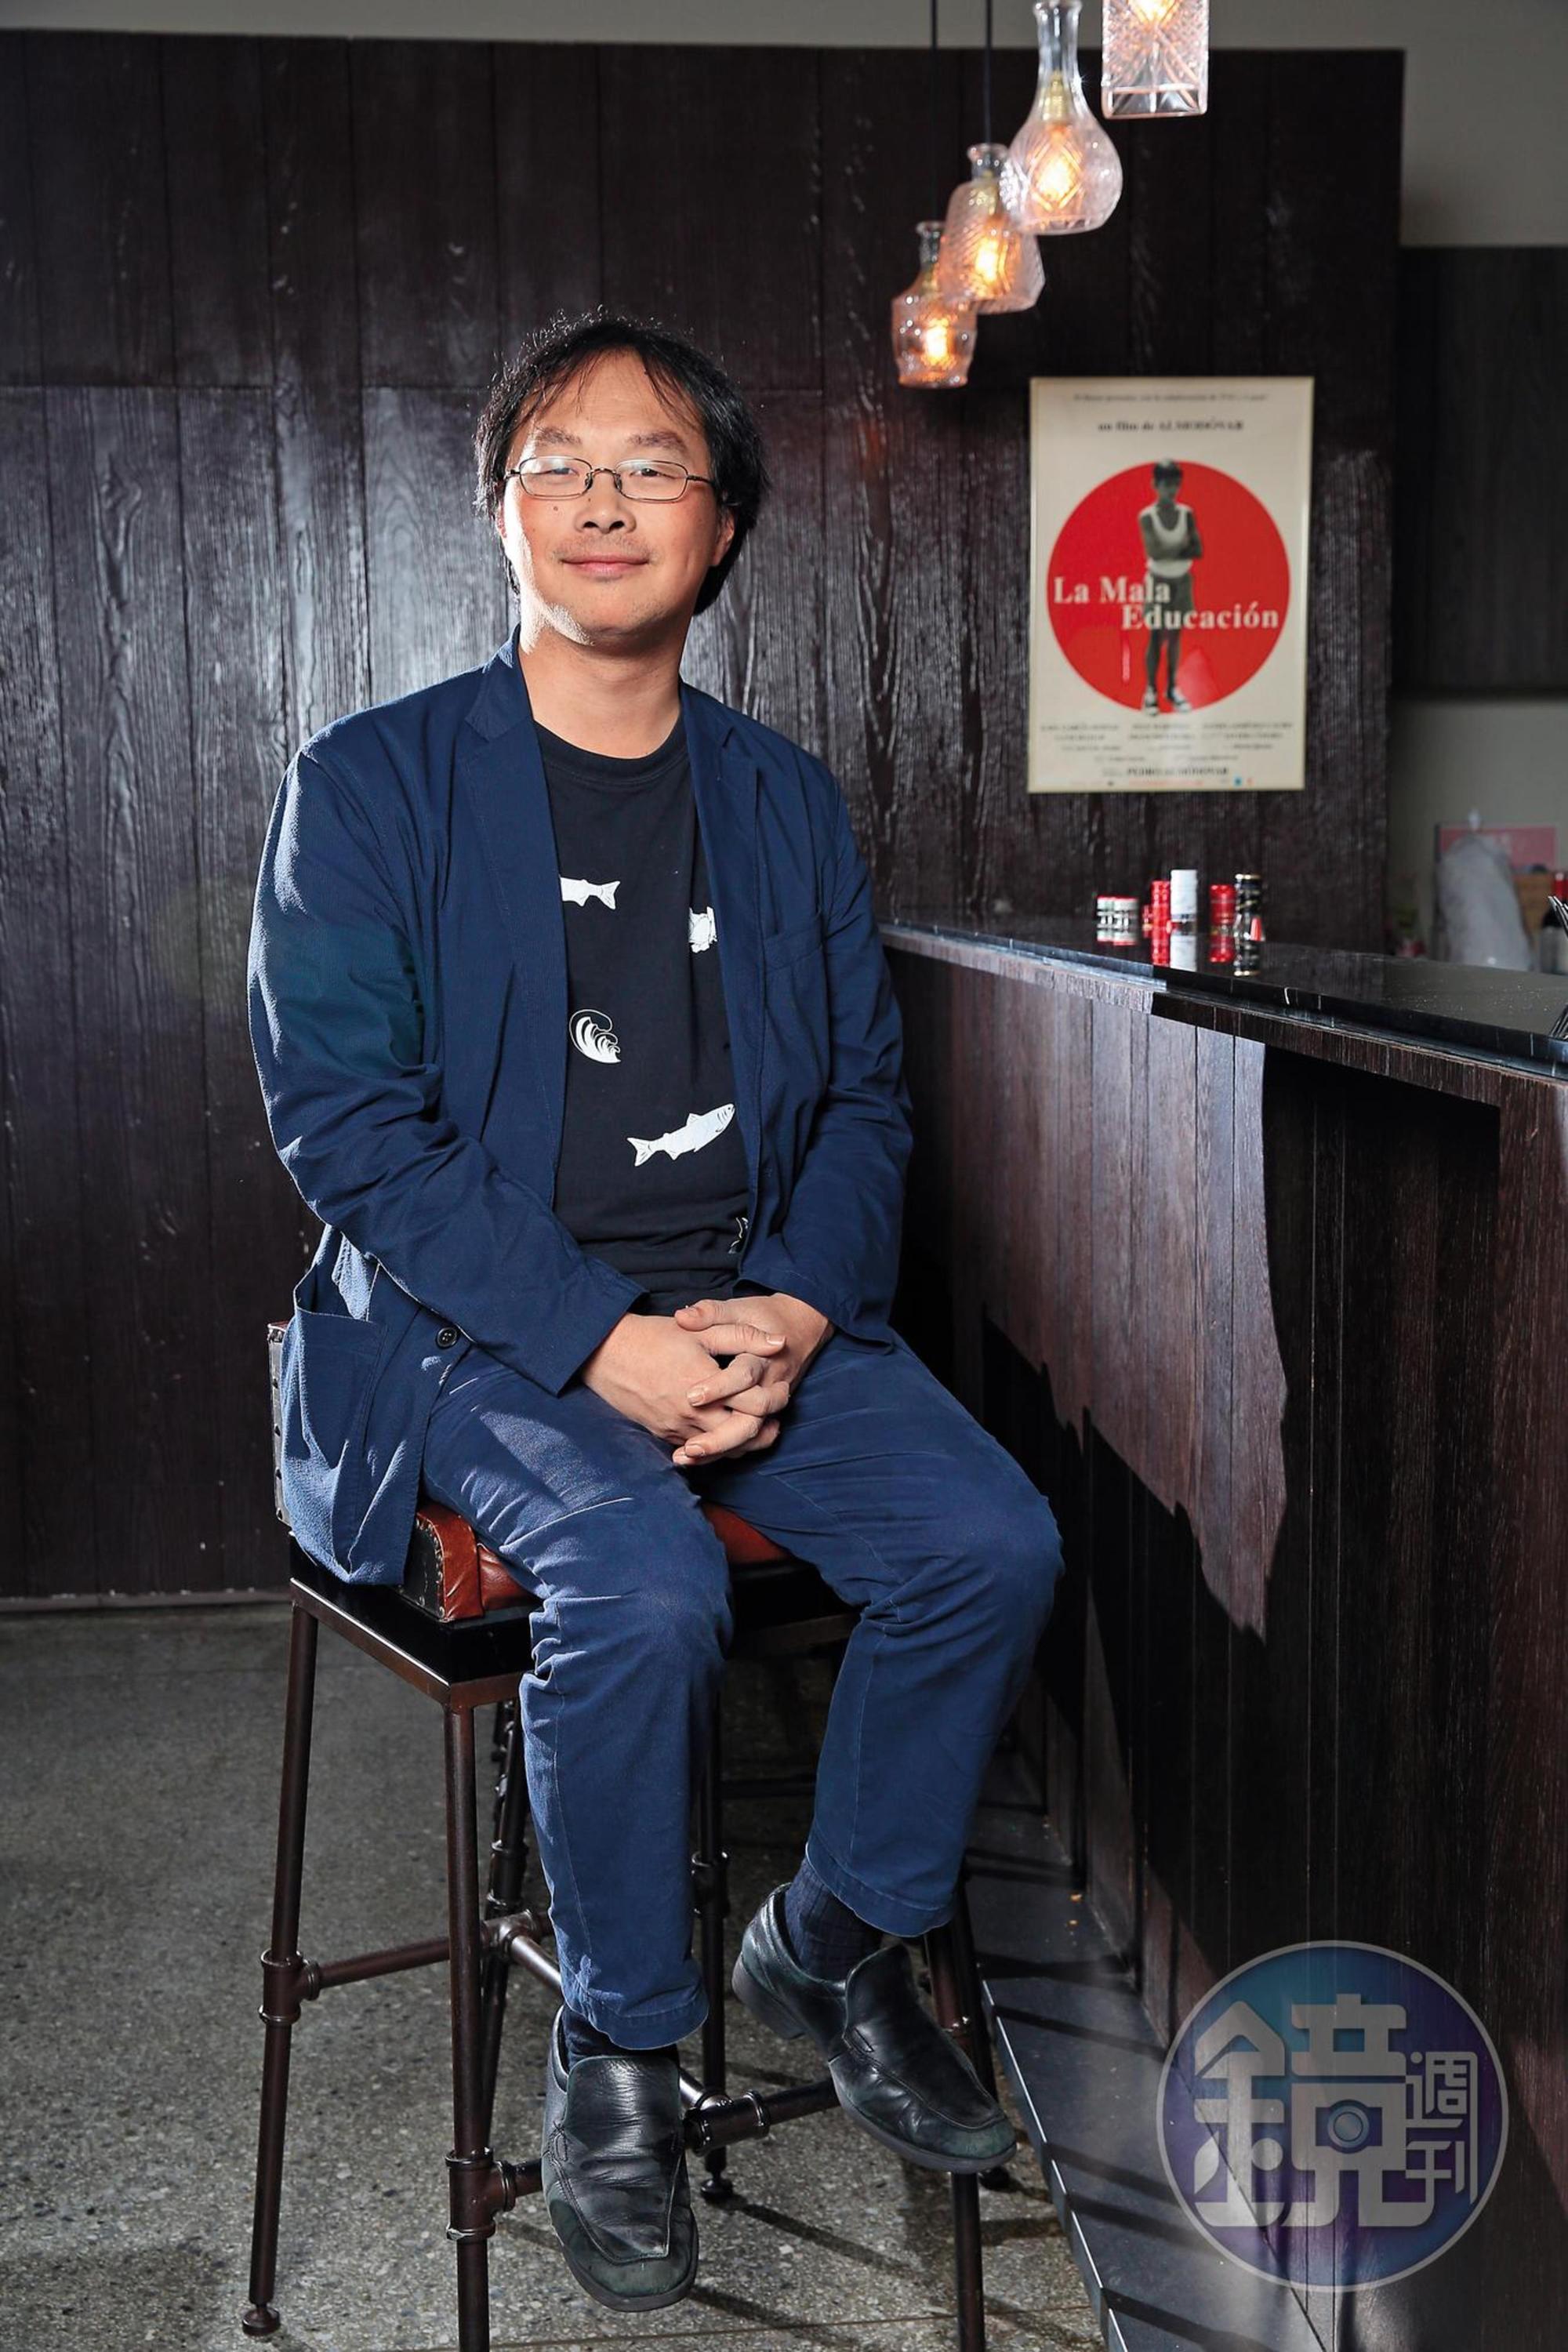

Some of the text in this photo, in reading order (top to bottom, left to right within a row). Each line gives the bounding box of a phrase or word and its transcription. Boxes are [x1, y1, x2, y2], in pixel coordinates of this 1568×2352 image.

[1054, 573, 1171, 604] La Mala
[1121, 601, 1279, 630] Educación
